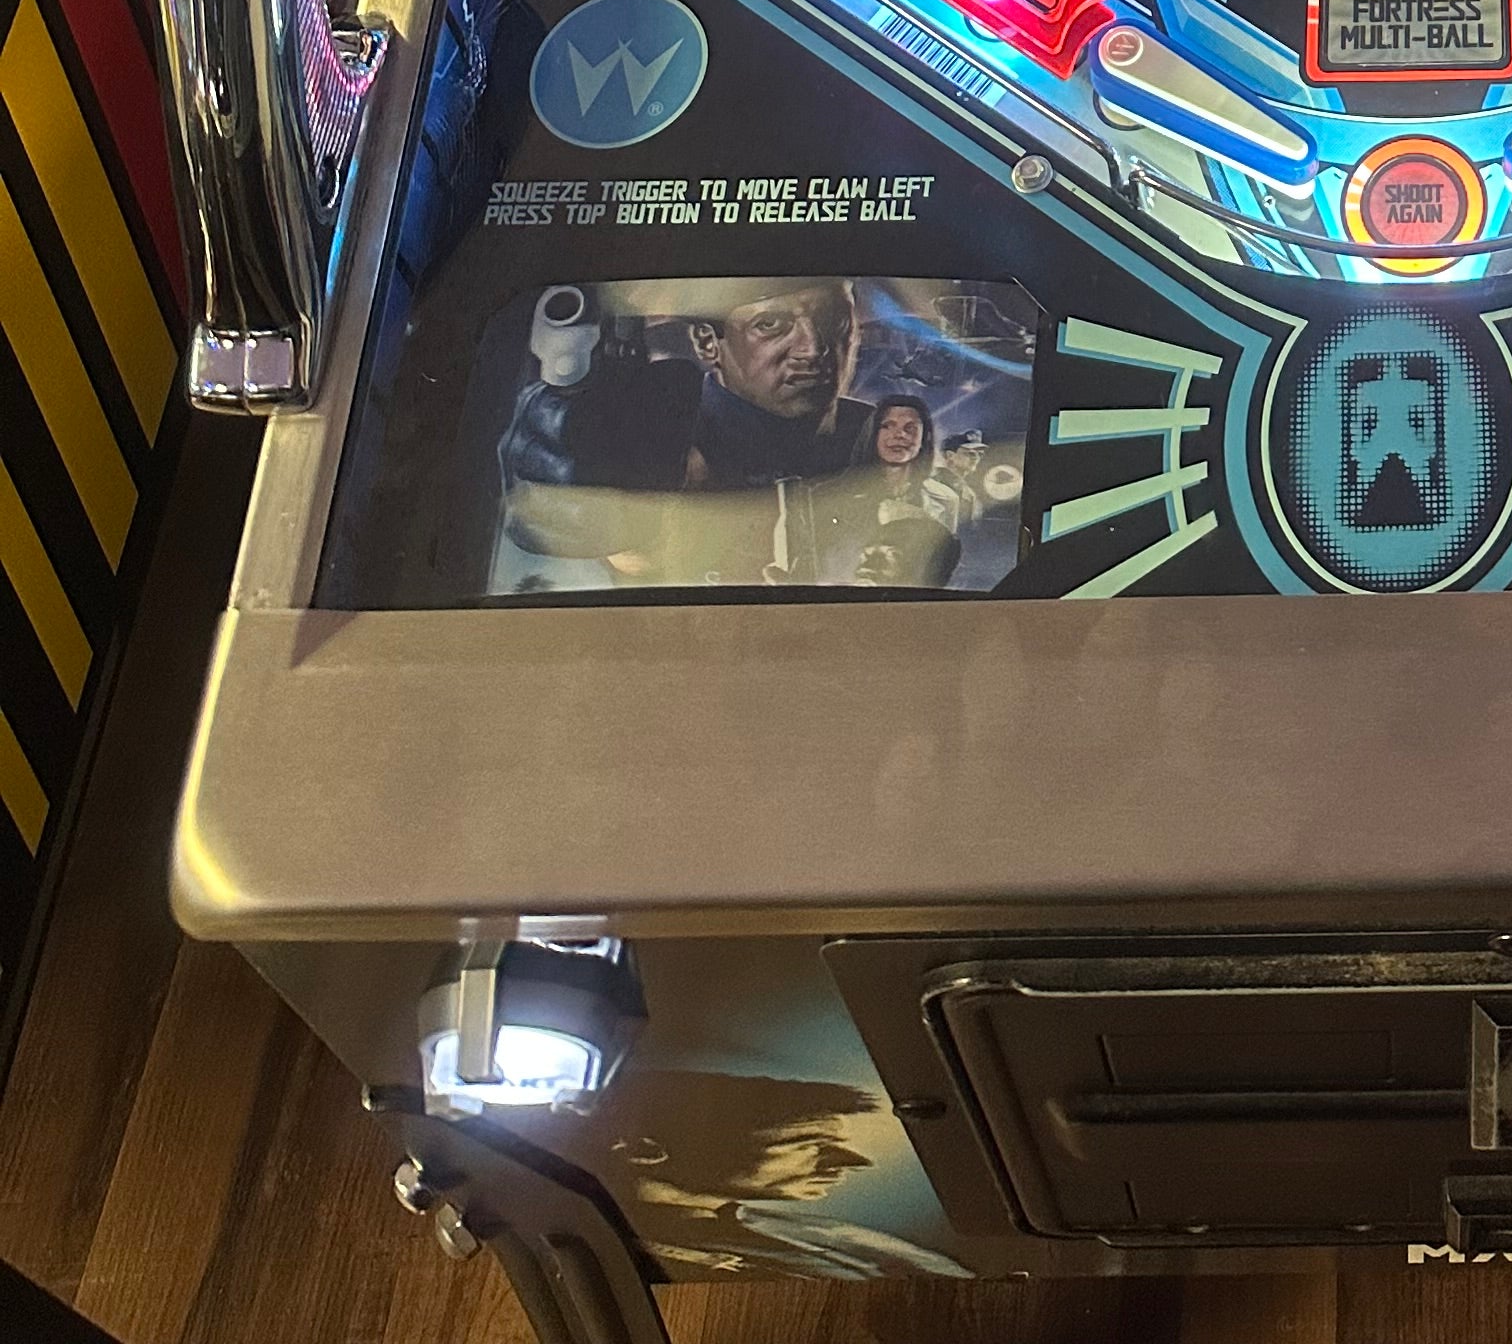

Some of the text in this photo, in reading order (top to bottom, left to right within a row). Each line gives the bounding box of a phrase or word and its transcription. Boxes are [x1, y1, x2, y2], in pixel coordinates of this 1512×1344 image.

[1341, 23, 1494, 50] MULTI-BALL
[489, 175, 935, 203] SQUEEZE TRIGGER TO MOVE CLAW LEFT
[1384, 183, 1445, 203] SHOOT
[484, 199, 917, 226] PRESS TOP BUTTON TO RELEASE BALL
[1386, 204, 1443, 224] AGAIN
